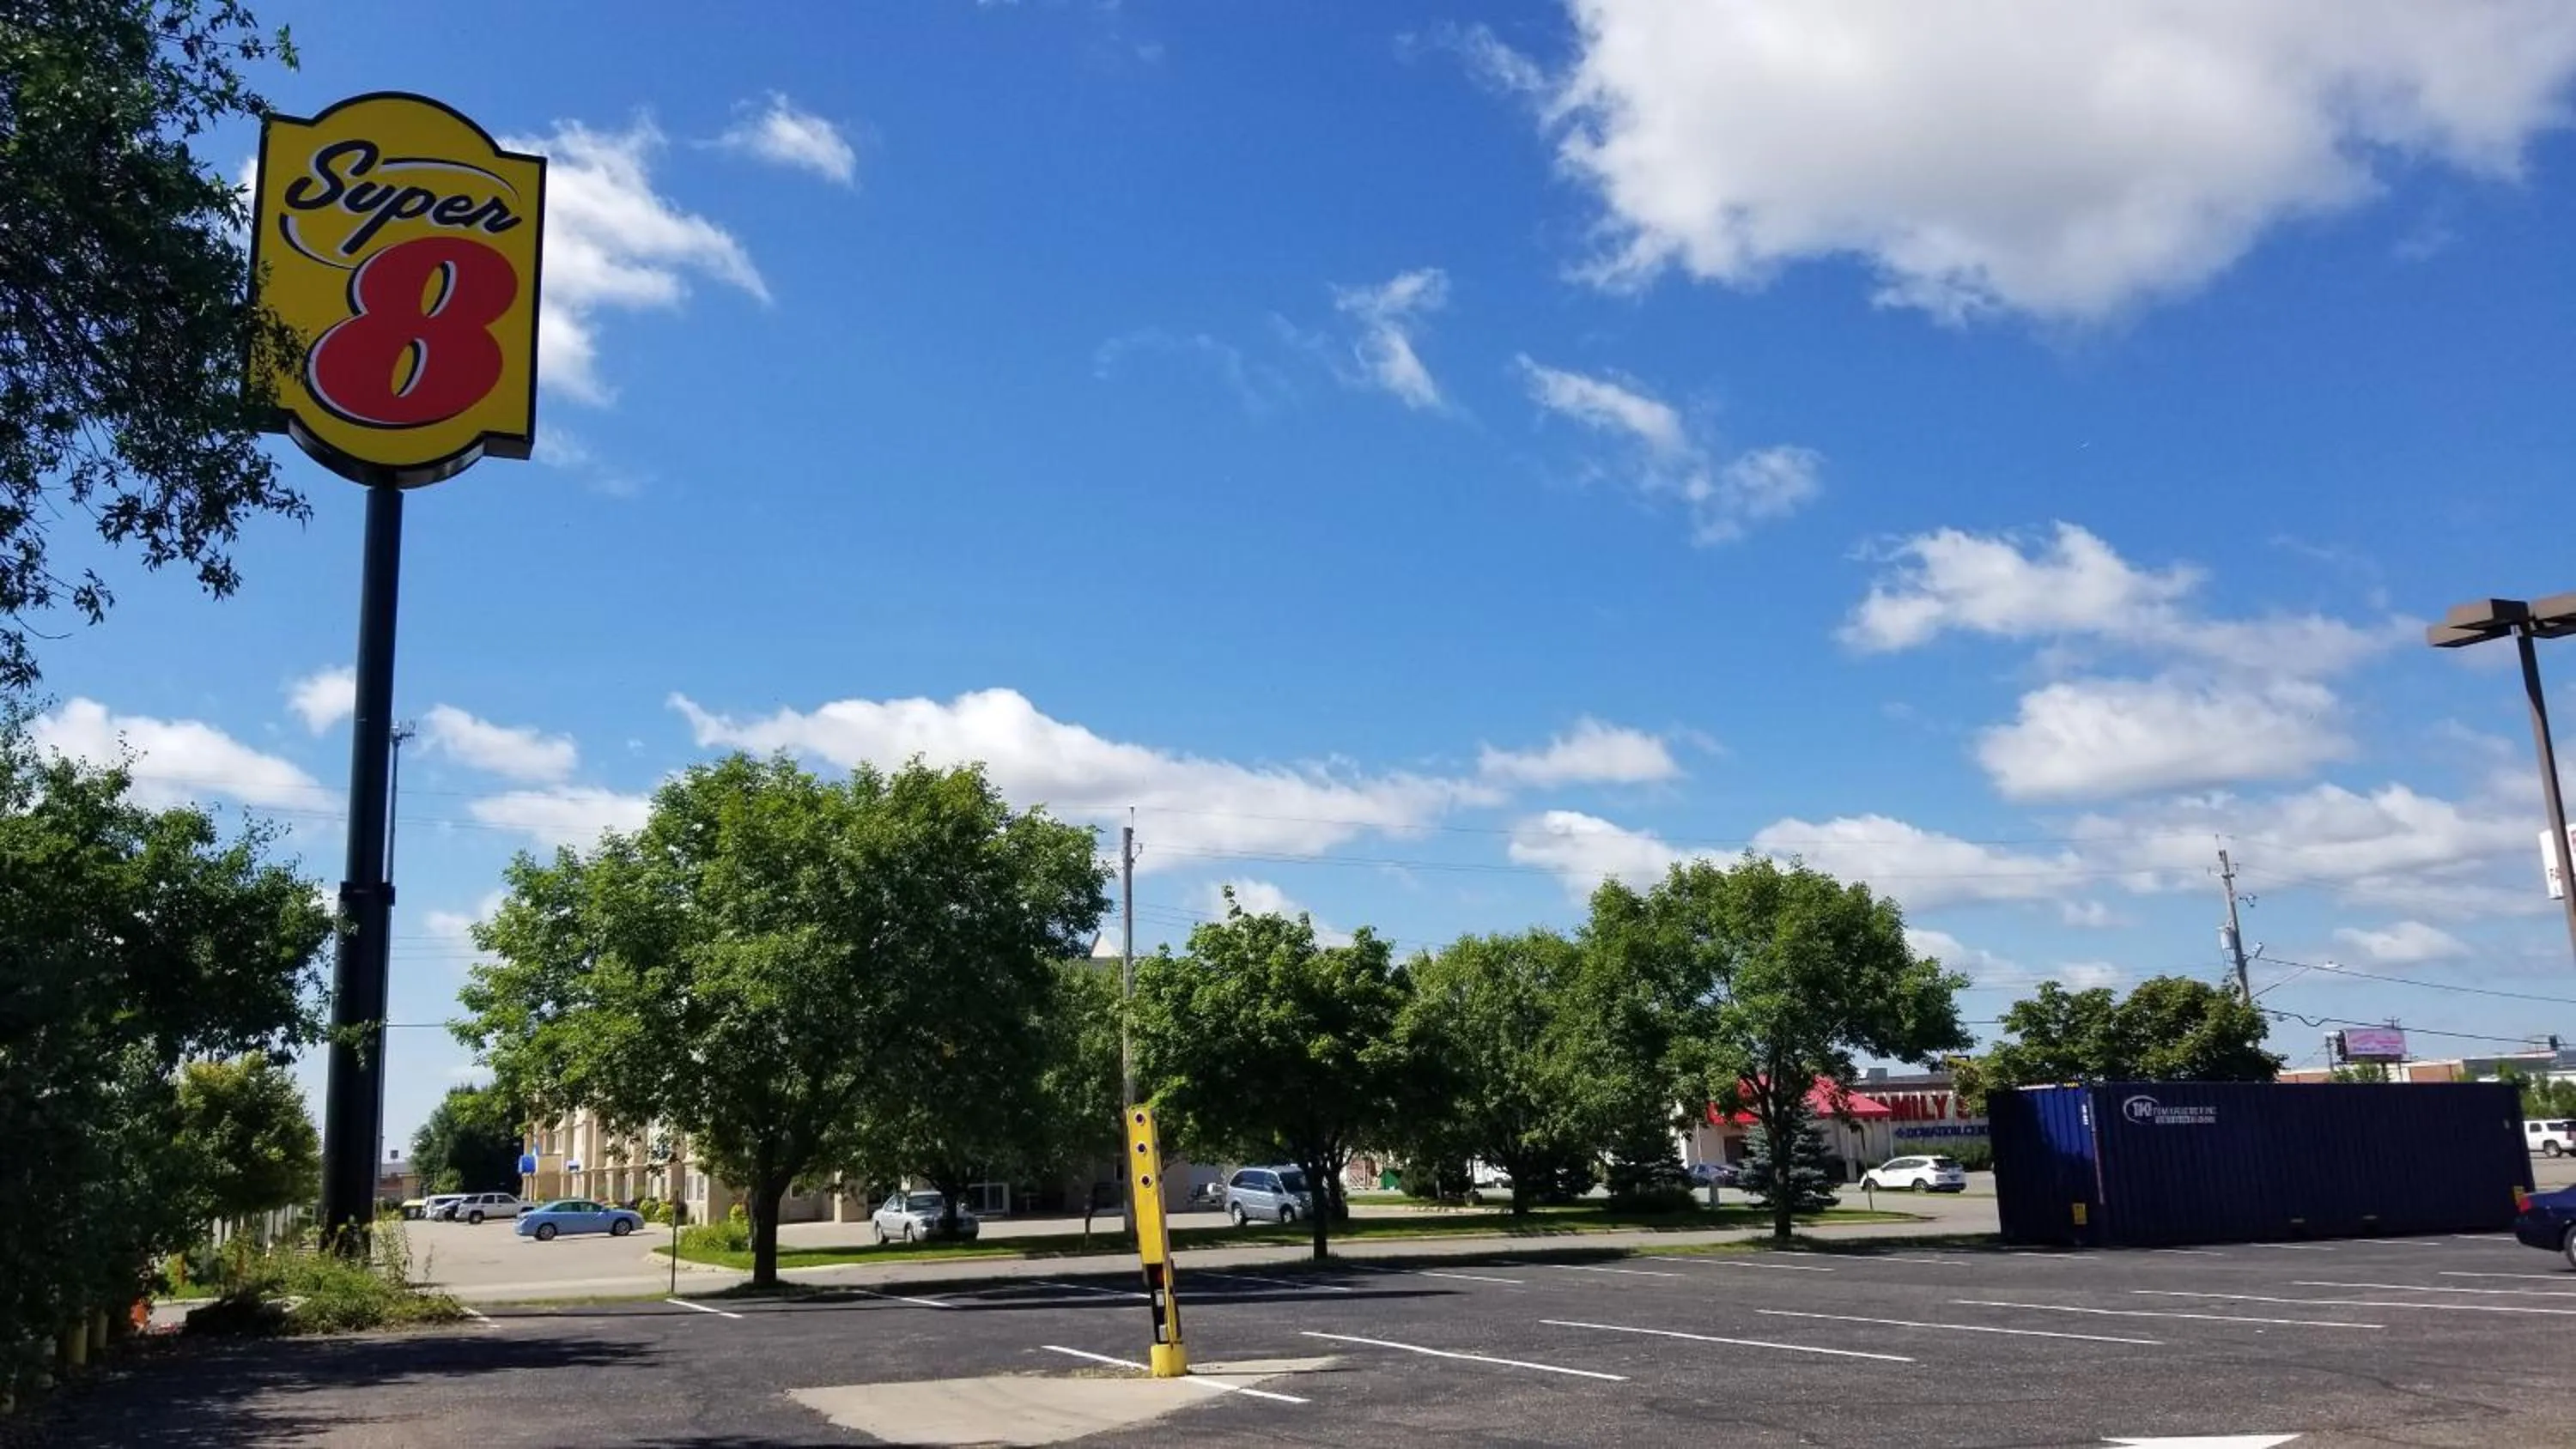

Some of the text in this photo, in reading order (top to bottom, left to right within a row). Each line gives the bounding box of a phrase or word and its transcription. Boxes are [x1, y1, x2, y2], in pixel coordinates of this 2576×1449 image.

[284, 139, 522, 255] Super
[304, 236, 519, 430] 8
[1863, 1094, 1948, 1121] AMILY
